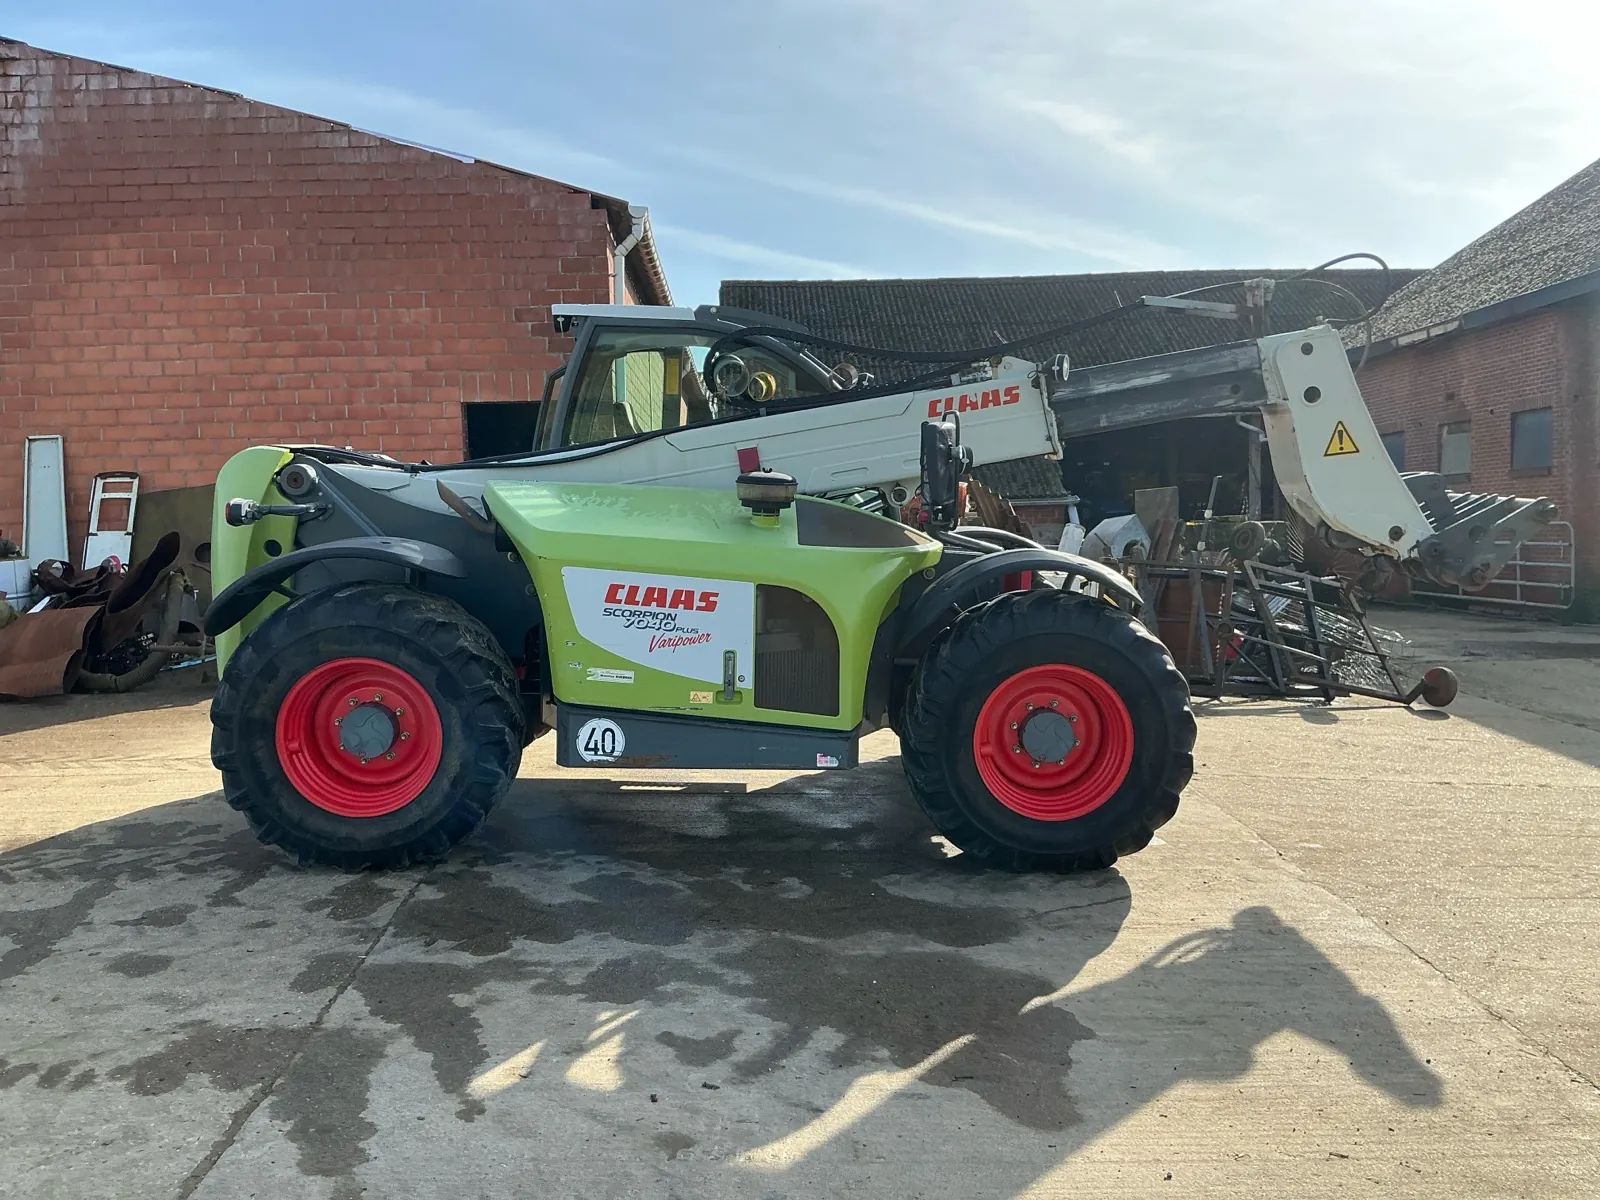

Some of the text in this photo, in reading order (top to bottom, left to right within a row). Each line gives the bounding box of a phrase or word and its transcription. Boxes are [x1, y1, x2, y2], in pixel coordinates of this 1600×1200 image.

[928, 385, 1020, 418] CLAAS
[604, 583, 720, 613] CLAAS
[602, 607, 678, 622] SCORPION
[623, 617, 677, 632] 7040
[648, 632, 712, 653] Varipower
[584, 727, 616, 755] 40
